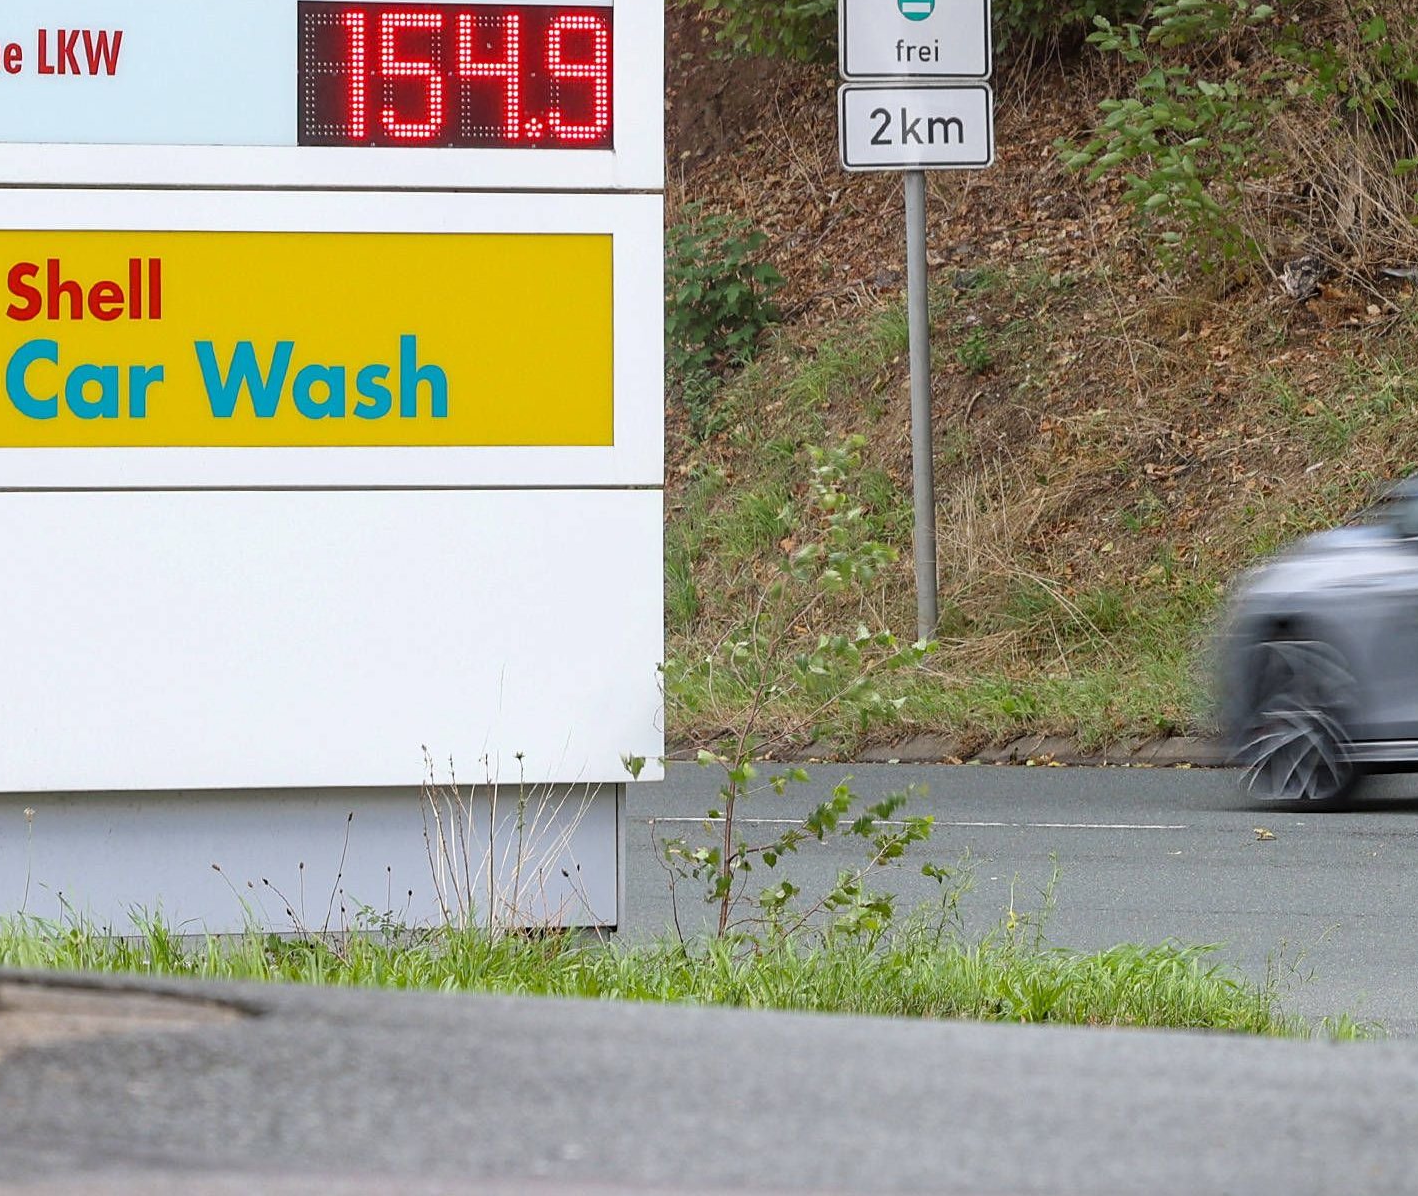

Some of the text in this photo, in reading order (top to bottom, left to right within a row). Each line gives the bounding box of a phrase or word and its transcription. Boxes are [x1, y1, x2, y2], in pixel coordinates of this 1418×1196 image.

[38, 28, 124, 76] LKW
[341, 10, 609, 143] 154.9
[896, 39, 939, 62] frei
[6, 258, 163, 322] Shell
[6, 334, 448, 420] Car Wash
